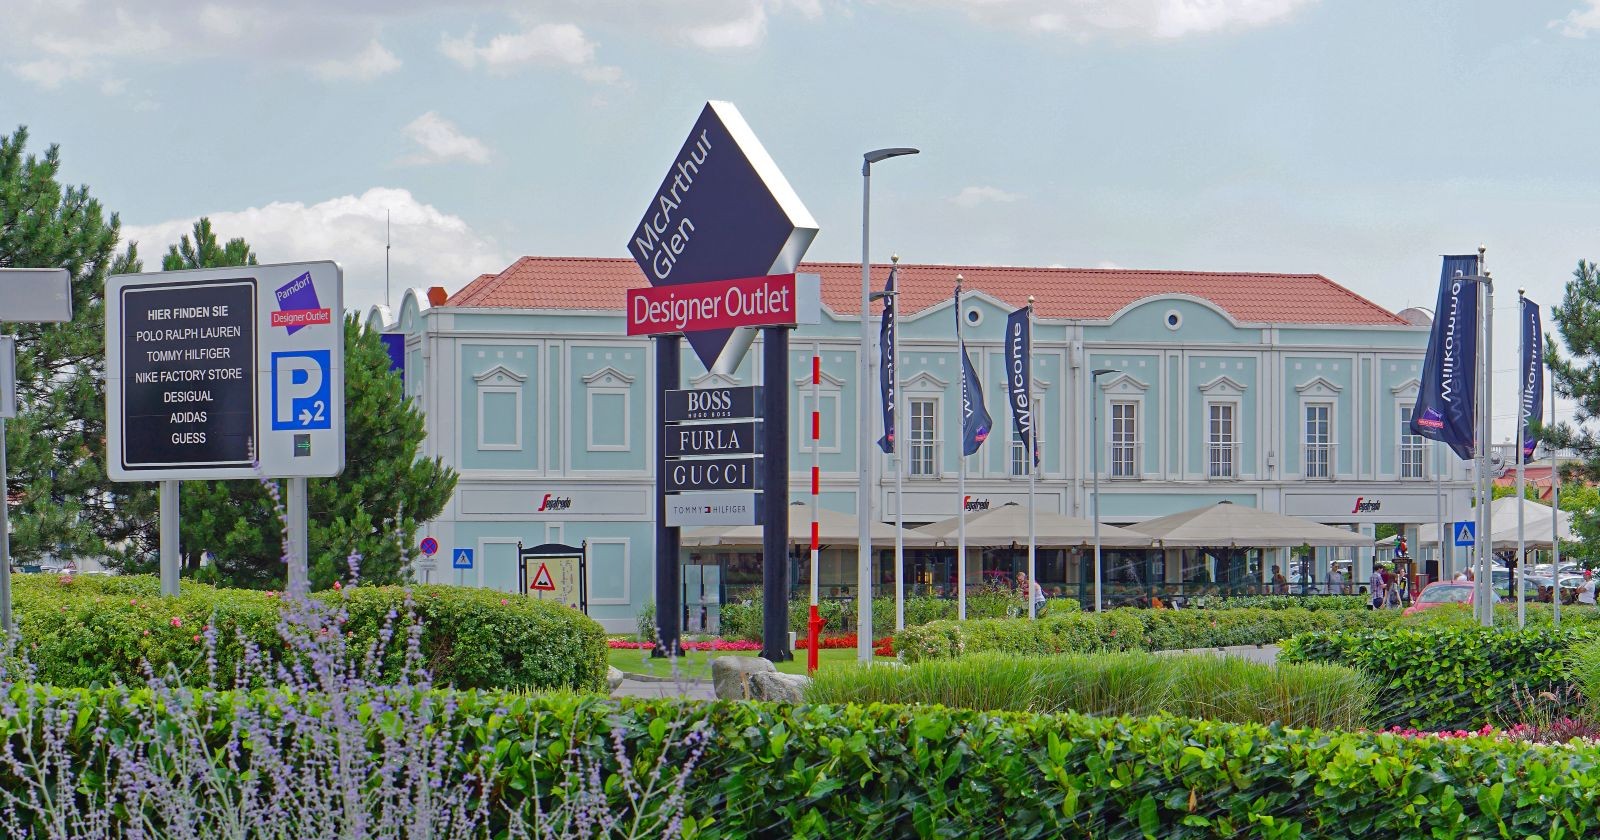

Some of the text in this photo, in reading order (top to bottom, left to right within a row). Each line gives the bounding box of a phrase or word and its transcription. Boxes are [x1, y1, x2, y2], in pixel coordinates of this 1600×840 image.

[636, 129, 712, 260] McArthur
[653, 217, 695, 279] Glen
[277, 273, 310, 301] Parndorf
[147, 305, 229, 321] HIER FINDEN SIE
[634, 283, 789, 329] Designer Outlet
[273, 310, 329, 325] Designer Outlet
[136, 326, 241, 342] POLO RALPH LAUREN
[147, 348, 231, 363] TOMMY HILFIGER
[135, 368, 242, 383] NIKE FACTORY STORE
[1013, 322, 1030, 433] Welcome
[163, 390, 213, 403] DESIGUAL
[277, 356, 323, 423] P
[687, 390, 732, 411] BOSS
[170, 411, 207, 424] ADIDAS
[313, 400, 325, 421] 2
[171, 432, 206, 444] GUESS
[679, 429, 740, 450] FURLA
[673, 464, 747, 485] GUCCI
[538, 494, 571, 511] Segafredo
[674, 505, 746, 514] TOMMY HILFIGER
